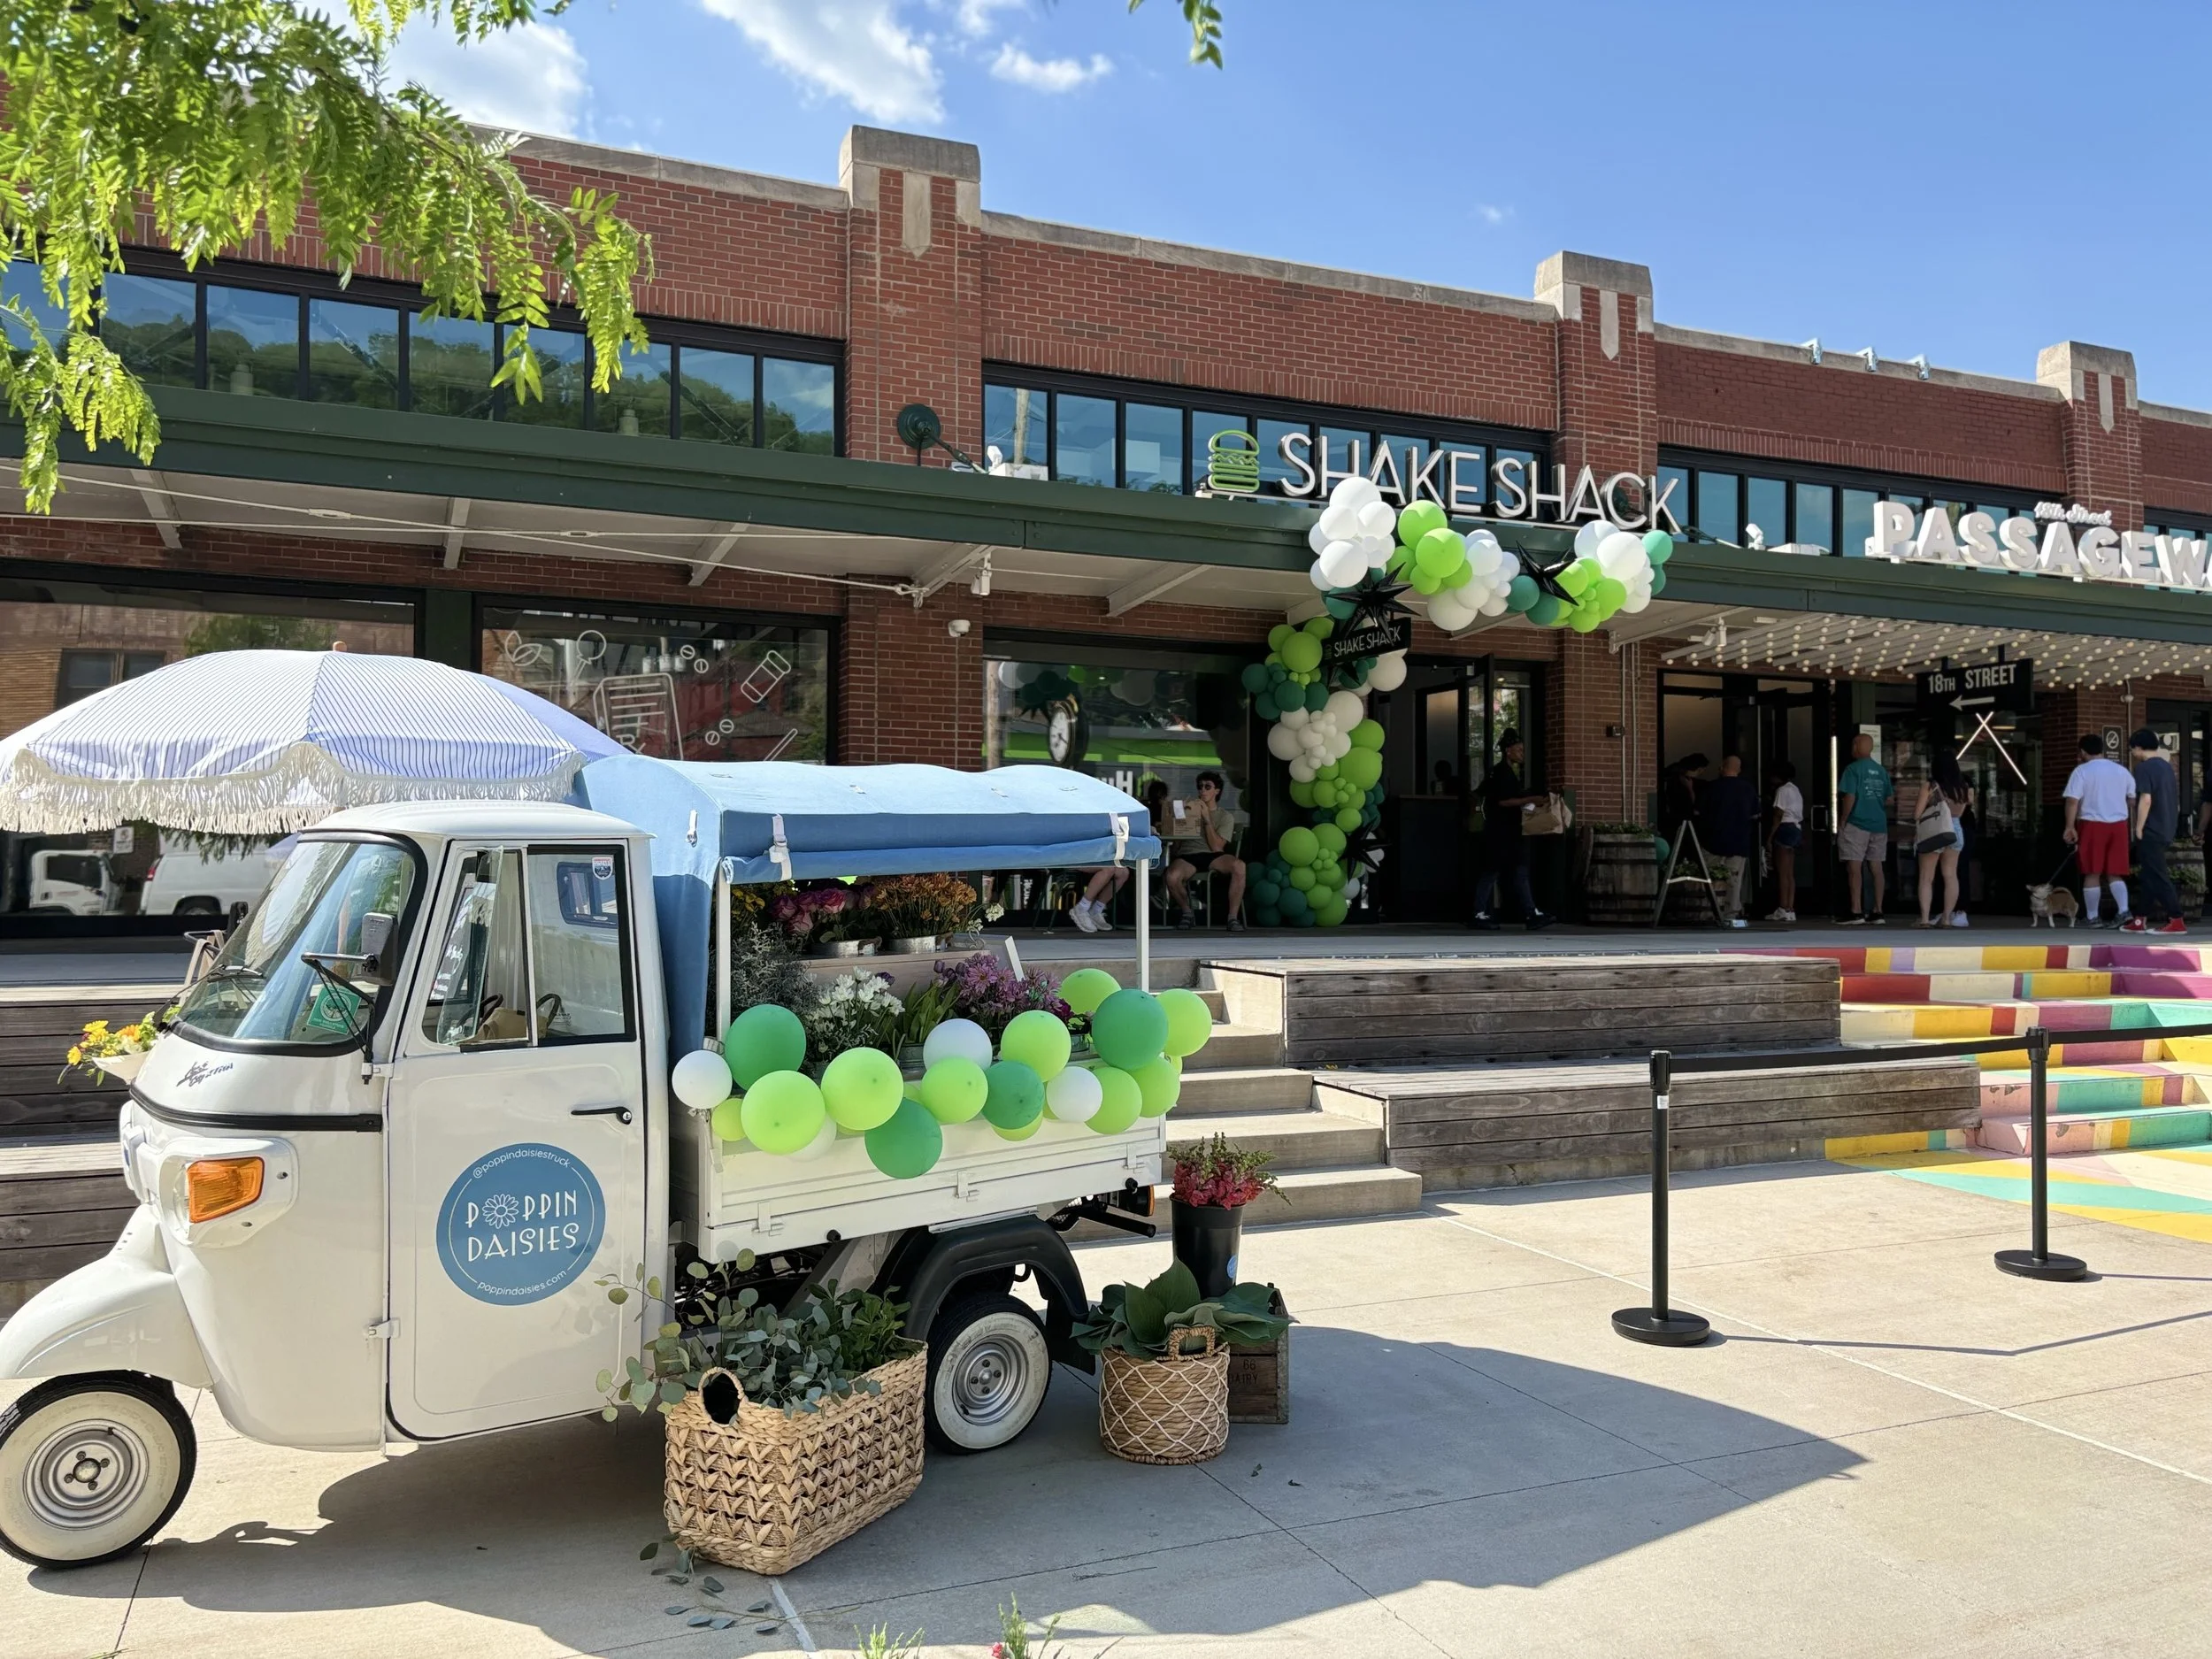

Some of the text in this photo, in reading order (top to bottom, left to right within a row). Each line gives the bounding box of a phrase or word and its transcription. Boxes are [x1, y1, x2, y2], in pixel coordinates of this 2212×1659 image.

[1277, 432, 1682, 534] SHAKE SHACK
[1873, 501, 2212, 588] PASSAGEW
[1333, 634, 1365, 657] SHAKE
[1927, 664, 2017, 694] 18TH STREET
[472, 1148, 571, 1179] @poppindaisiestruck
[467, 1222, 580, 1263] DAISIES
[476, 1269, 567, 1296] poppindaisies.com
